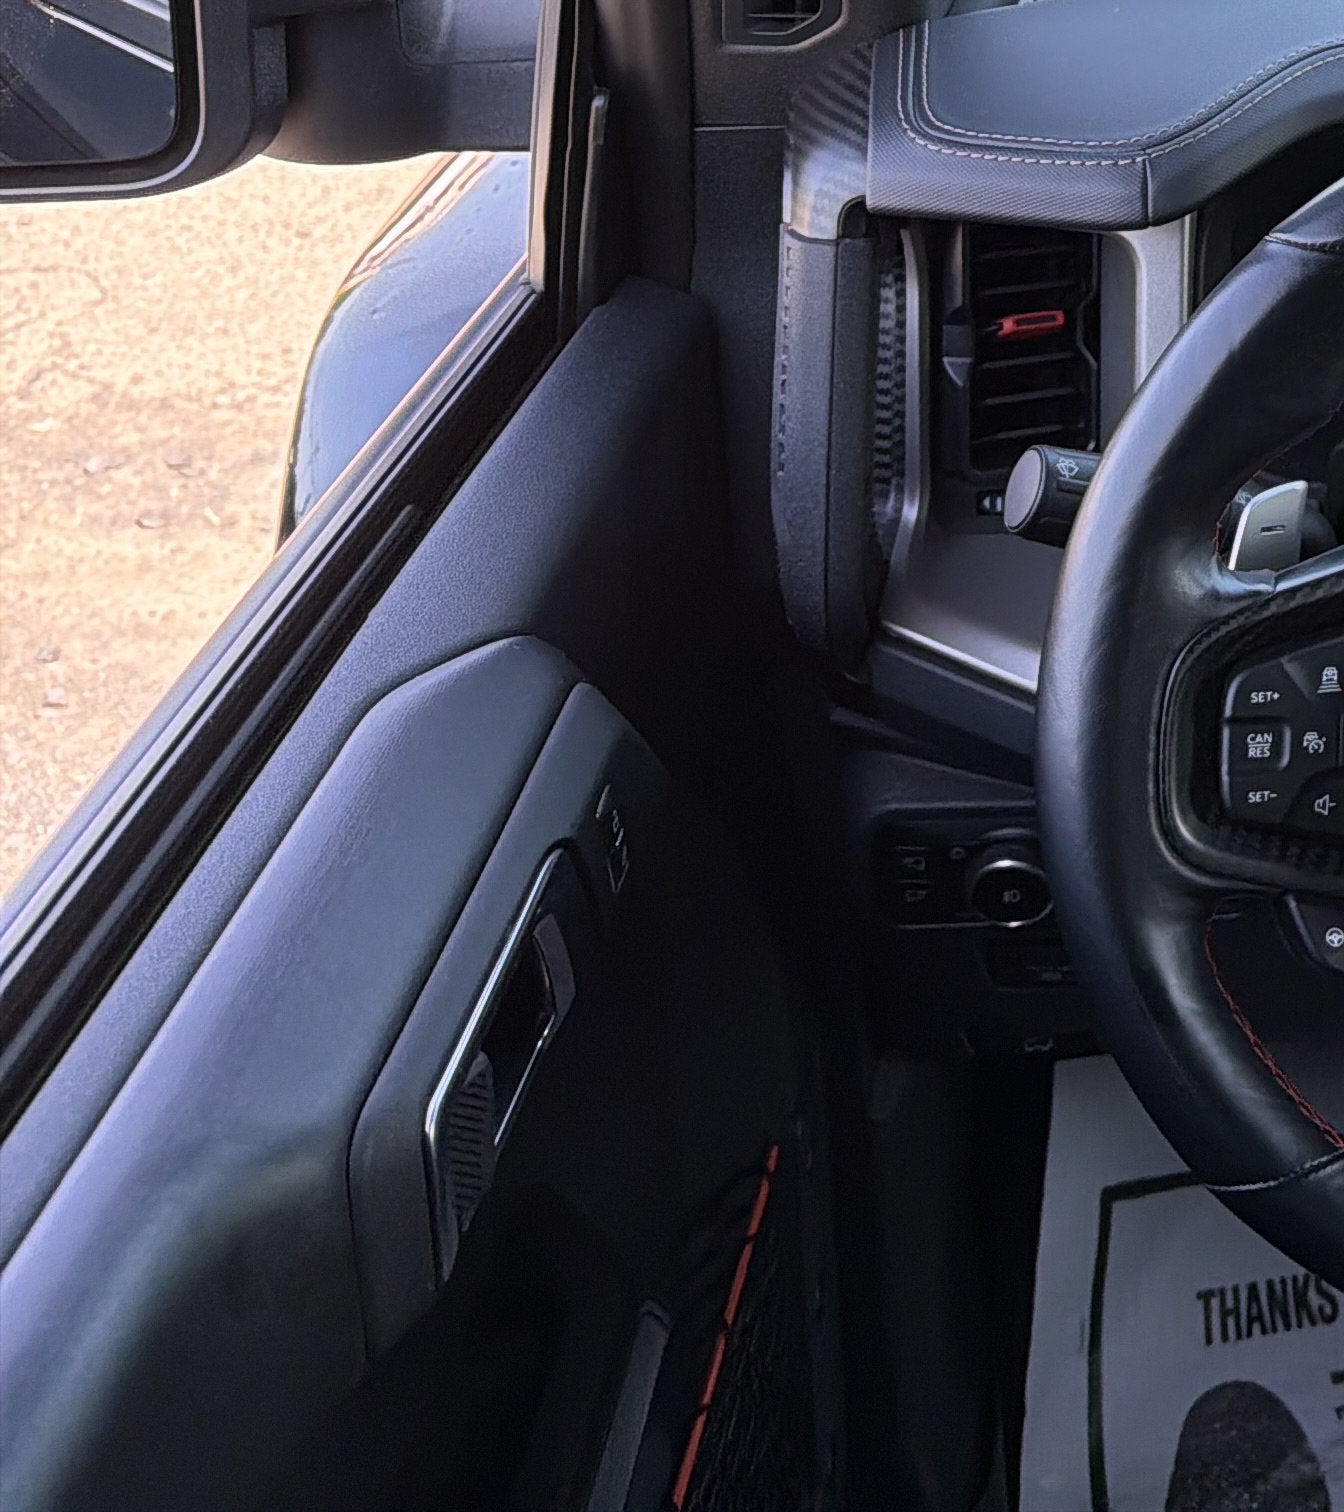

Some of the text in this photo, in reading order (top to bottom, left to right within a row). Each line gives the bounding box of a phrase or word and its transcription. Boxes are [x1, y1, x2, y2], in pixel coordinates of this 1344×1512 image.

[1247, 732, 1272, 744] CAN
[1247, 746, 1271, 758] RES
[1196, 1273, 1340, 1346] THANKS
